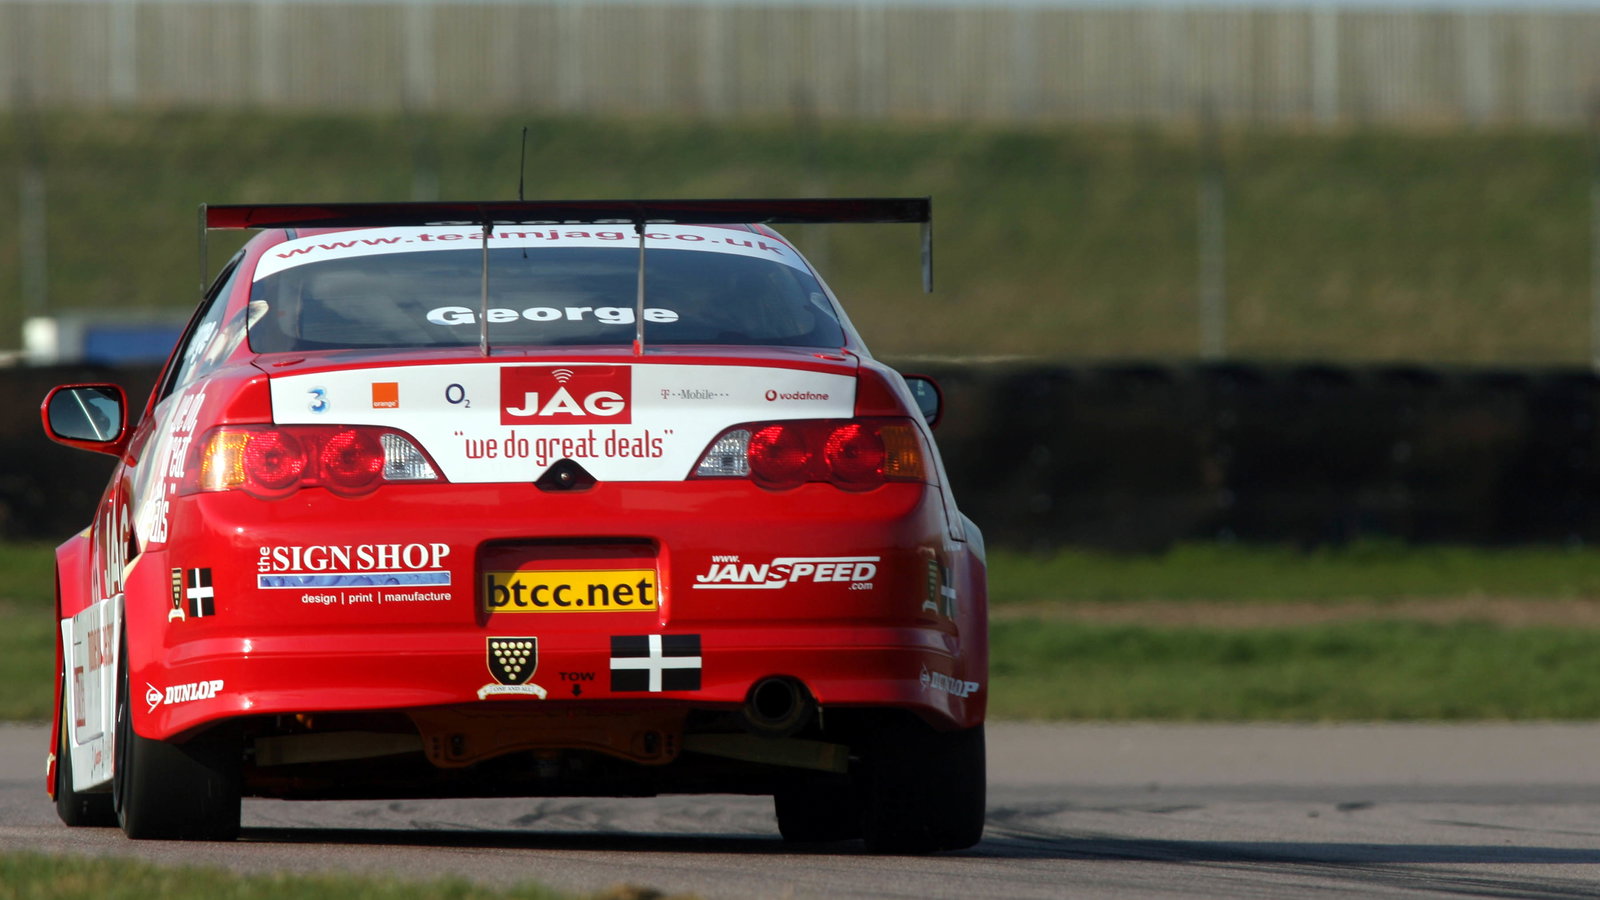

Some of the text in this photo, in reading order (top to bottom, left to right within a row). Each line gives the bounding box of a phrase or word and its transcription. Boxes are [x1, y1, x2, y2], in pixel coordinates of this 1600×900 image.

[426, 305, 679, 325] George
[307, 386, 329, 413] 3
[506, 385, 626, 417] JAG
[780, 391, 830, 401] vodafone
[504, 430, 529, 459] do
[536, 429, 599, 467] great
[257, 546, 271, 573] the
[273, 543, 451, 571] SIGN SHOP
[693, 558, 880, 587] JANSPEED
[302, 591, 452, 605] design print manufacture
[487, 574, 654, 608] btcc.net
[849, 583, 873, 591] .com
[559, 672, 596, 681] TOW
[930, 671, 980, 699] DUNLOP
[163, 680, 224, 704] DUNLOP
